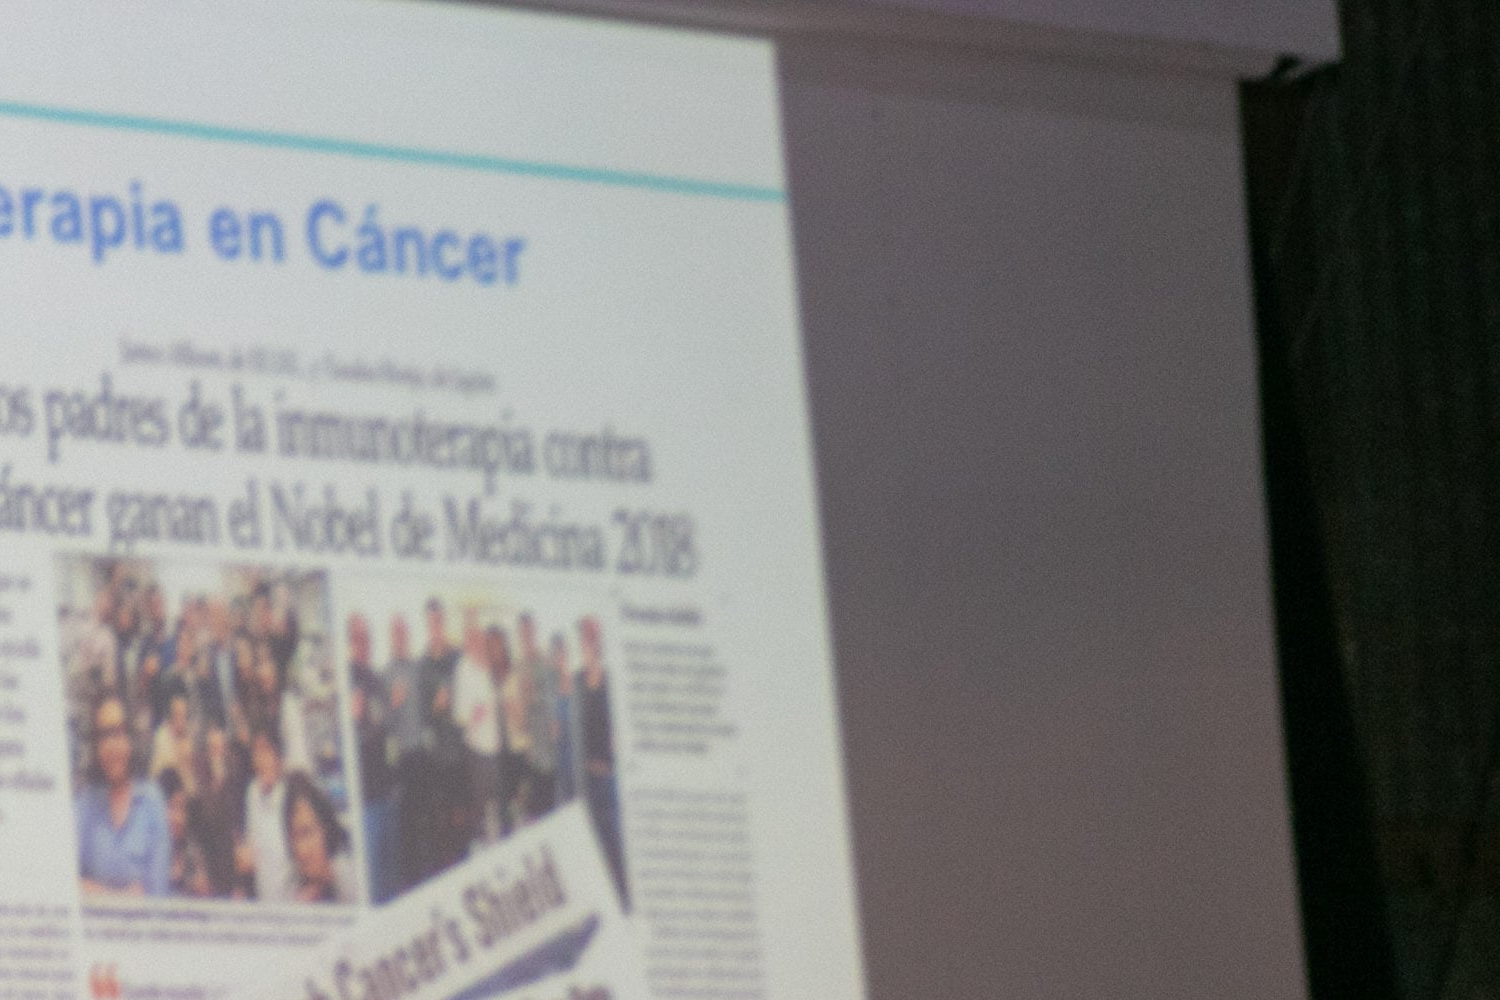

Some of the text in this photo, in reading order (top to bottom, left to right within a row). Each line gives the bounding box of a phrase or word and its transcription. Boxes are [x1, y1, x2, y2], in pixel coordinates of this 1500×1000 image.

[208, 207, 286, 263] en
[305, 197, 527, 288] Cáncer
[43, 370, 170, 464] padres
[178, 378, 225, 451] de
[231, 381, 266, 455] la
[275, 388, 535, 496] inmunoterapia
[544, 424, 654, 484] contra
[105, 489, 220, 556] ganan
[227, 478, 262, 549] el
[269, 479, 380, 558] Nobel
[389, 488, 436, 560] de
[443, 494, 606, 570] Medicina
[611, 508, 697, 579] 2018
[462, 842, 568, 950] Shield
